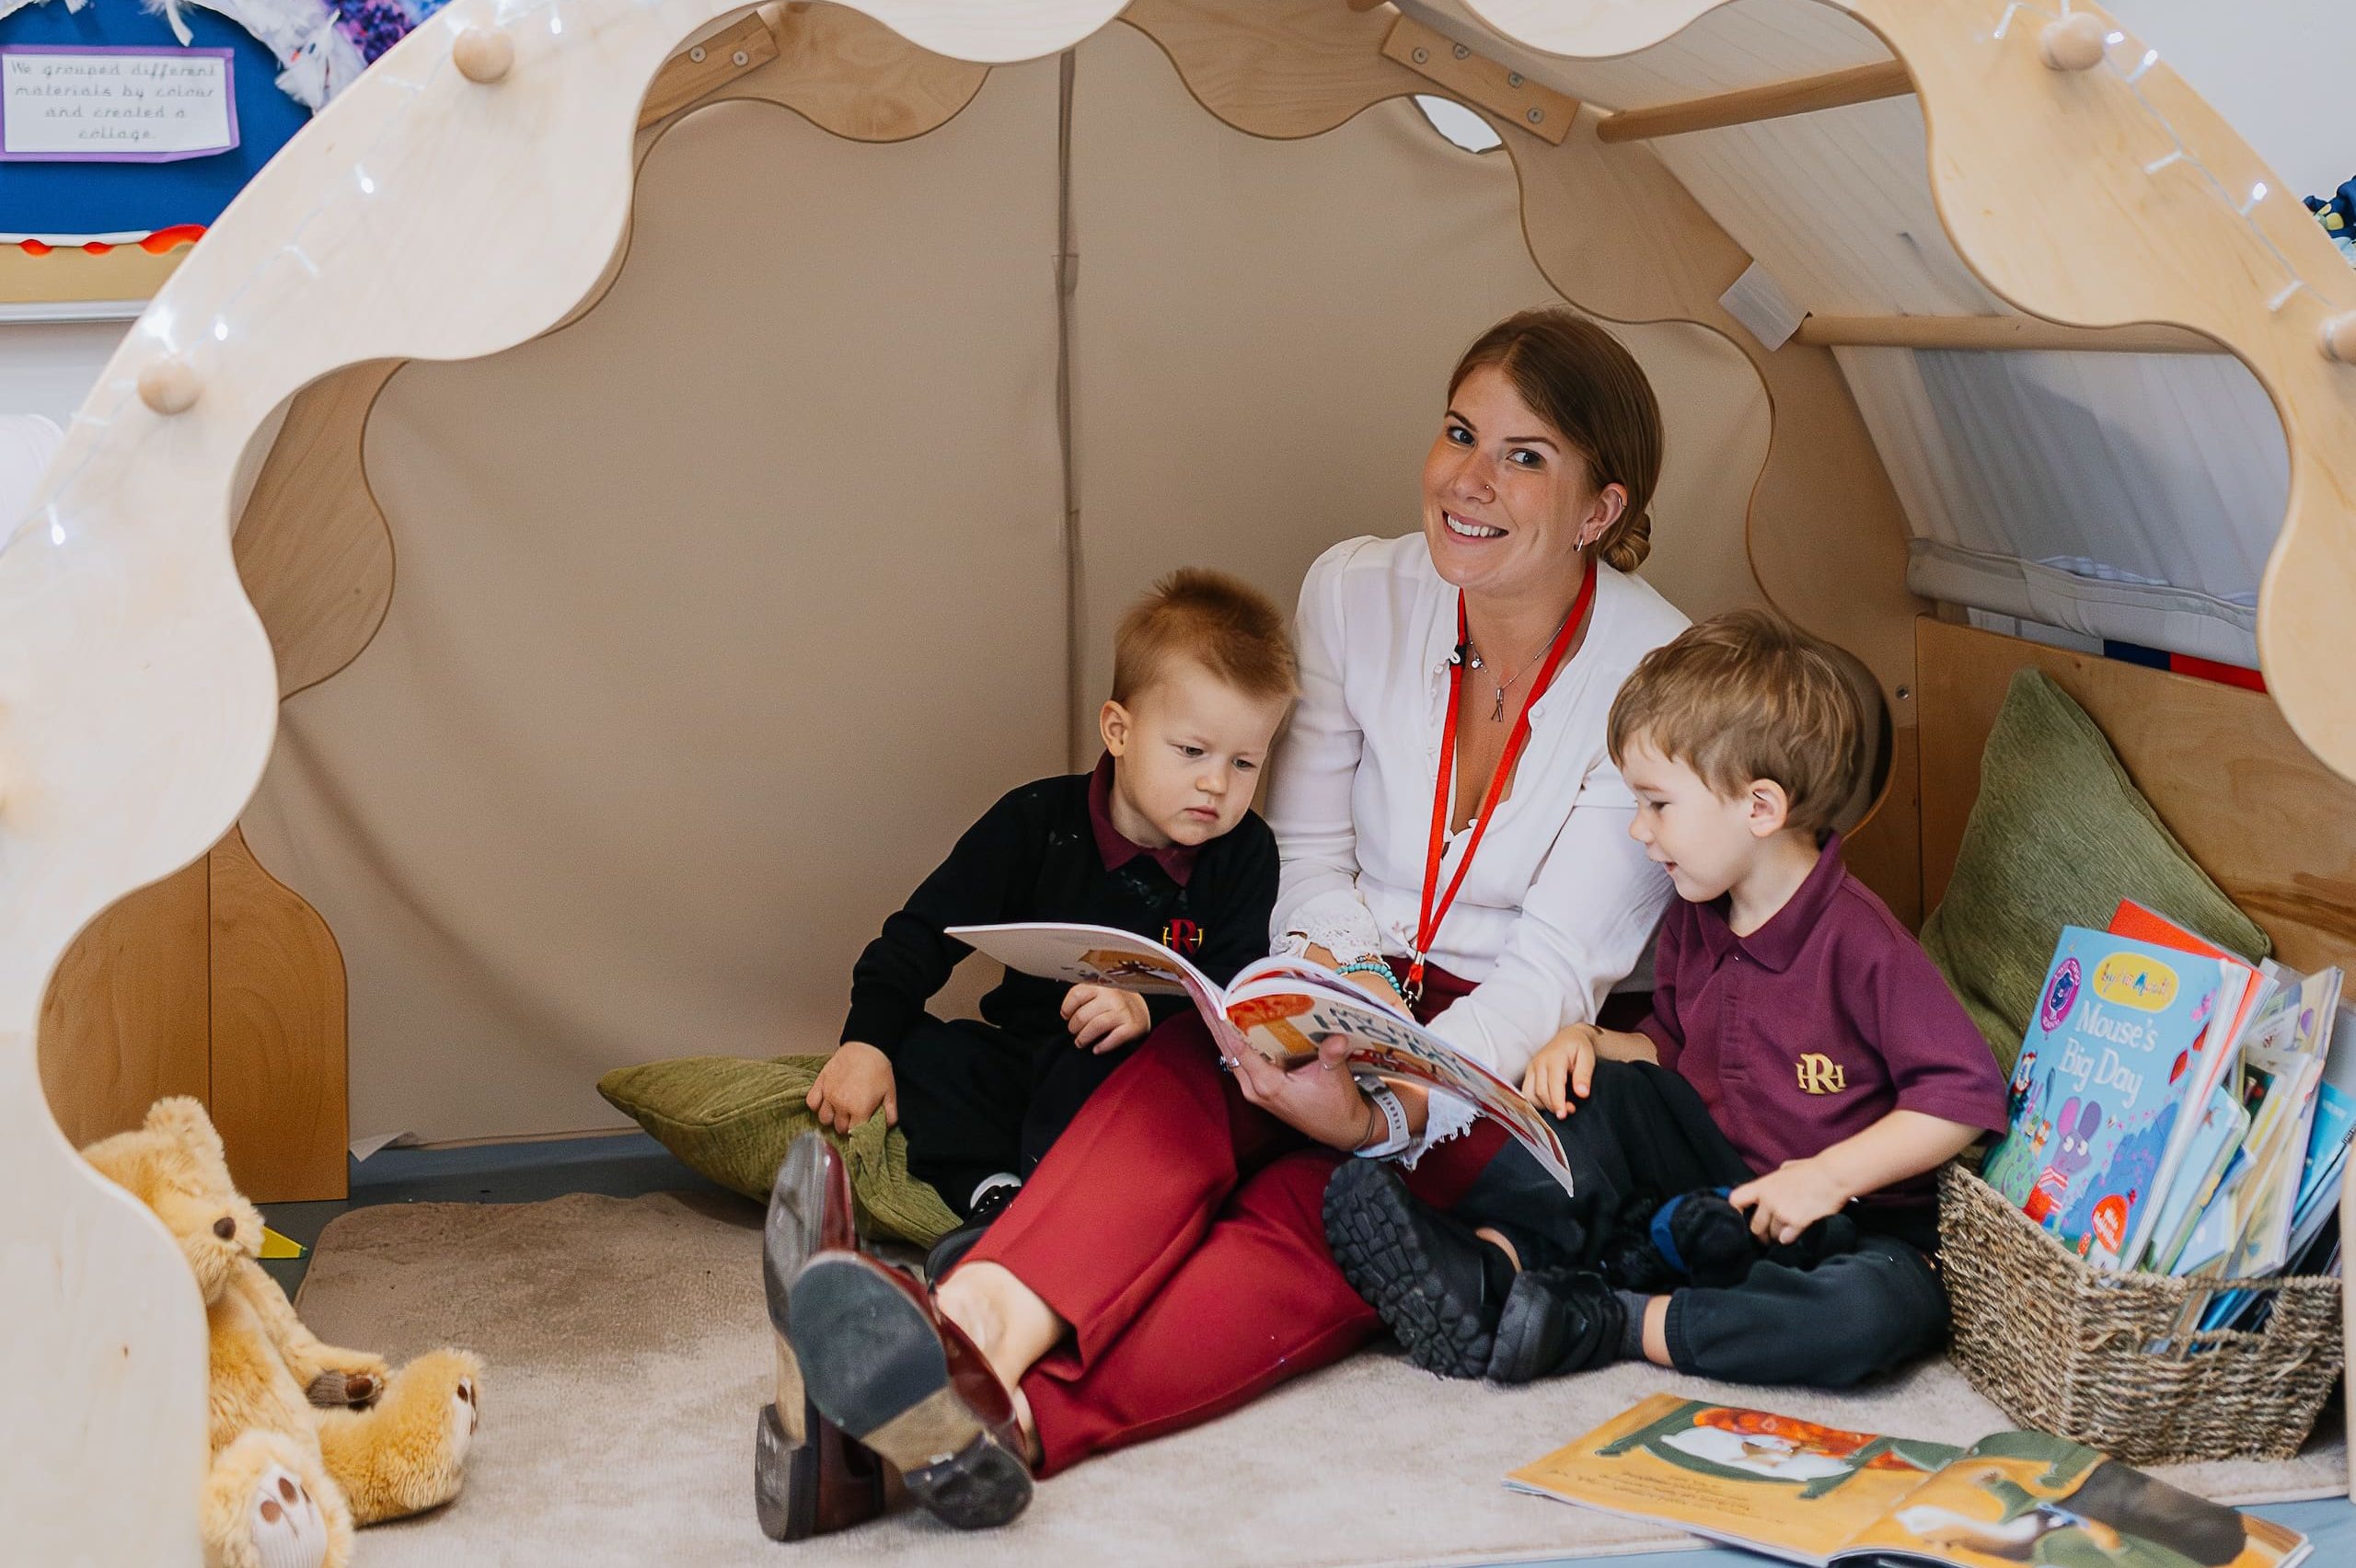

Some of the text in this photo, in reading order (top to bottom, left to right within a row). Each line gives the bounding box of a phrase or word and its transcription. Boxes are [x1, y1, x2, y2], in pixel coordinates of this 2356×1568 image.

[11, 61, 216, 80] We grouped different
[15, 84, 214, 99] materials by colour
[45, 105, 186, 118] and created a
[2075, 999, 2159, 1053] Mouse's
[2058, 1037, 2144, 1110] Big Day
